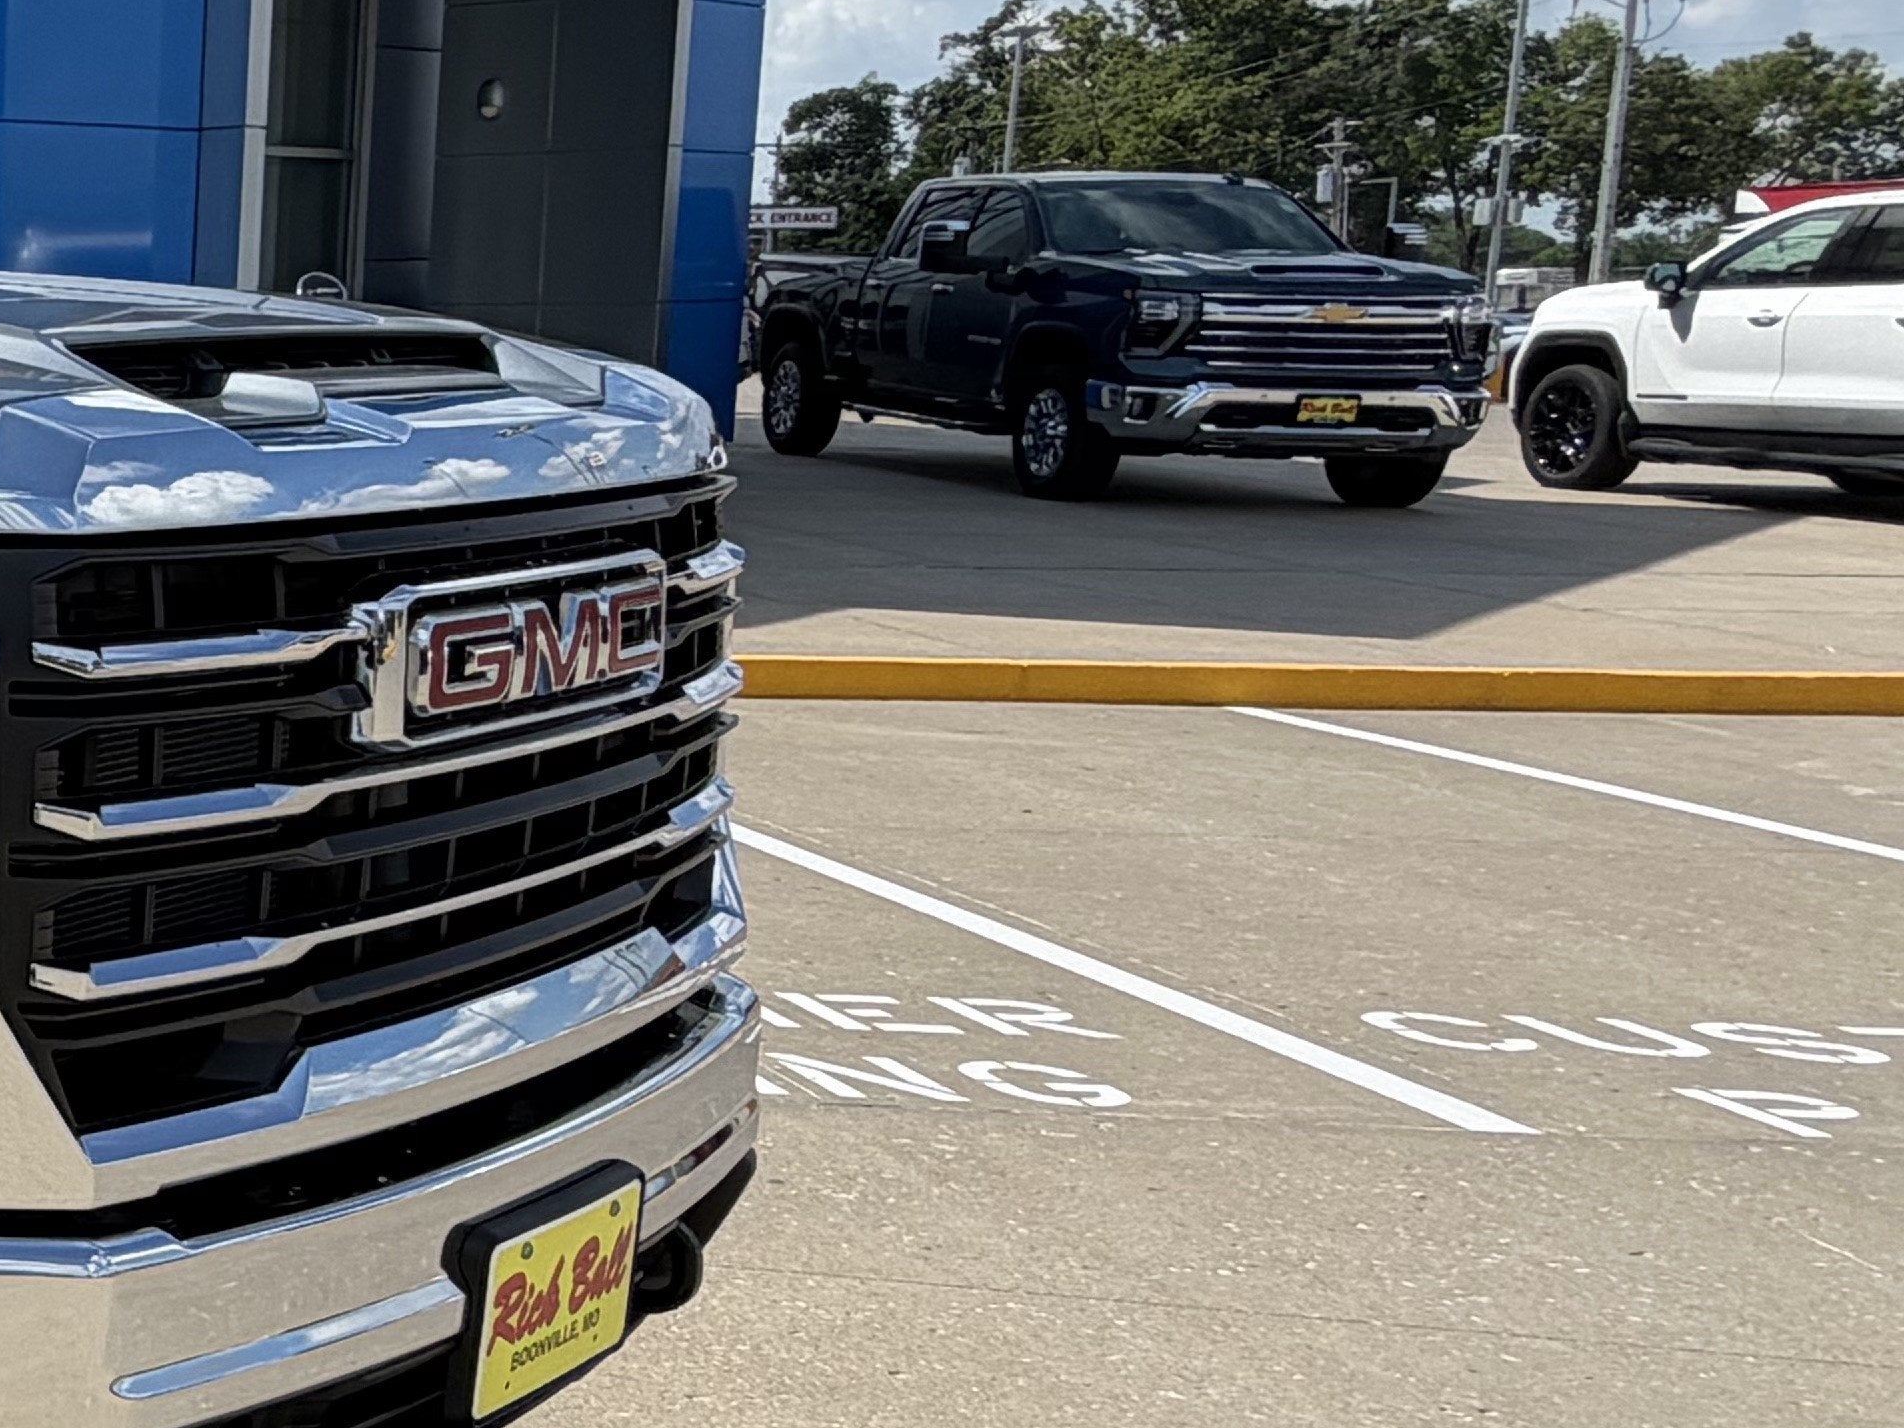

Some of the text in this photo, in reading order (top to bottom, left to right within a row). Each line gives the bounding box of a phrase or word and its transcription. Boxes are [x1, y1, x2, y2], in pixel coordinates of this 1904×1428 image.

[406, 578, 663, 718] GMC
[485, 1218, 634, 1359] Rick Ball
